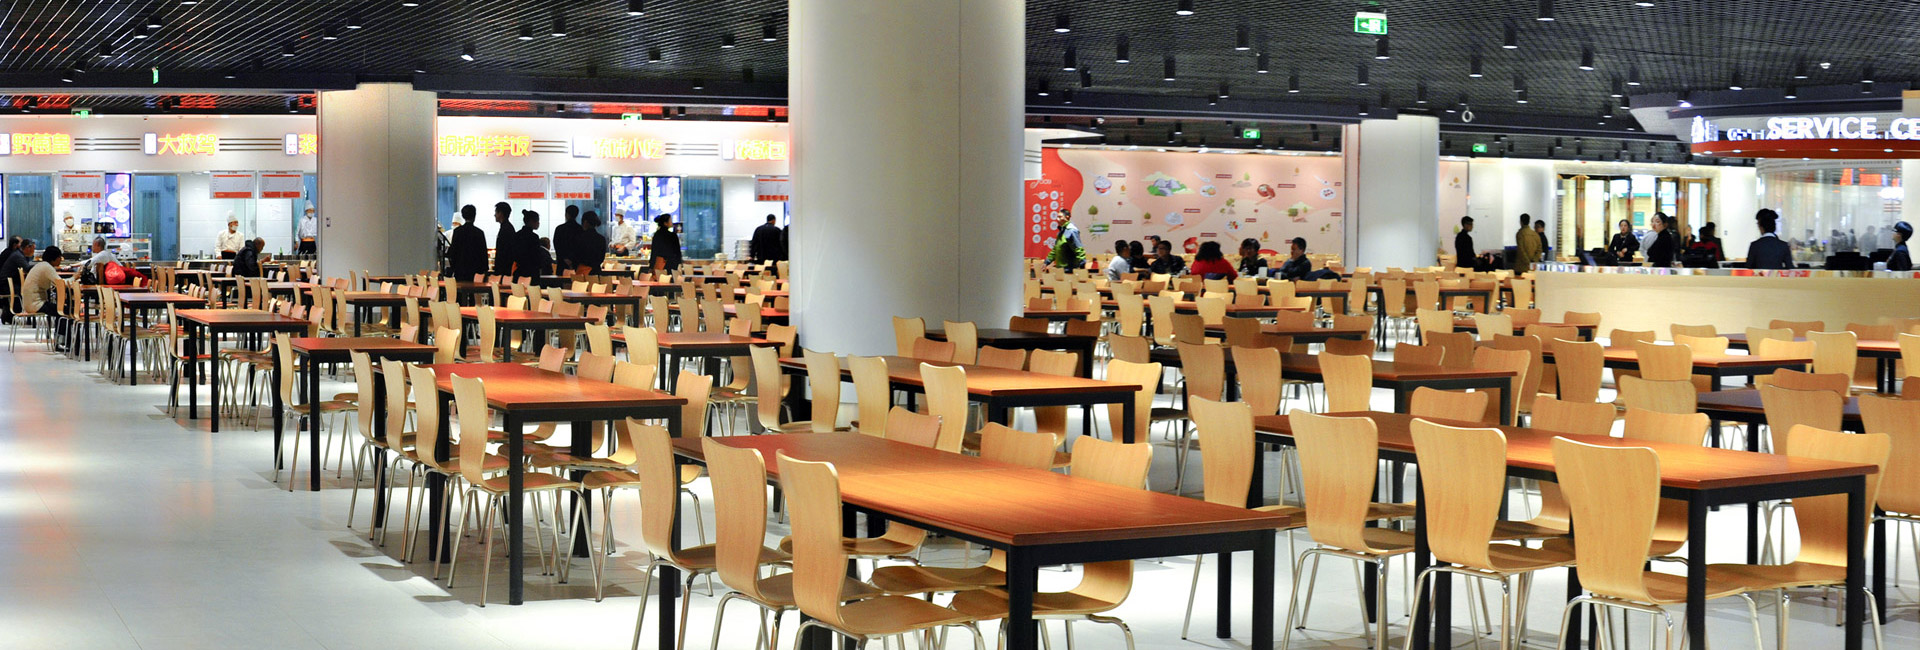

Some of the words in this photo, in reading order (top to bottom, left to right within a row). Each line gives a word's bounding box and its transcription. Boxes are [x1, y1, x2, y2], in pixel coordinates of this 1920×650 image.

[1767, 116, 1877, 139] SERVICE
[12, 133, 71, 154] 野菌皇
[158, 133, 216, 155] 大救驾
[439, 135, 530, 156] 铜锅洋芋饭
